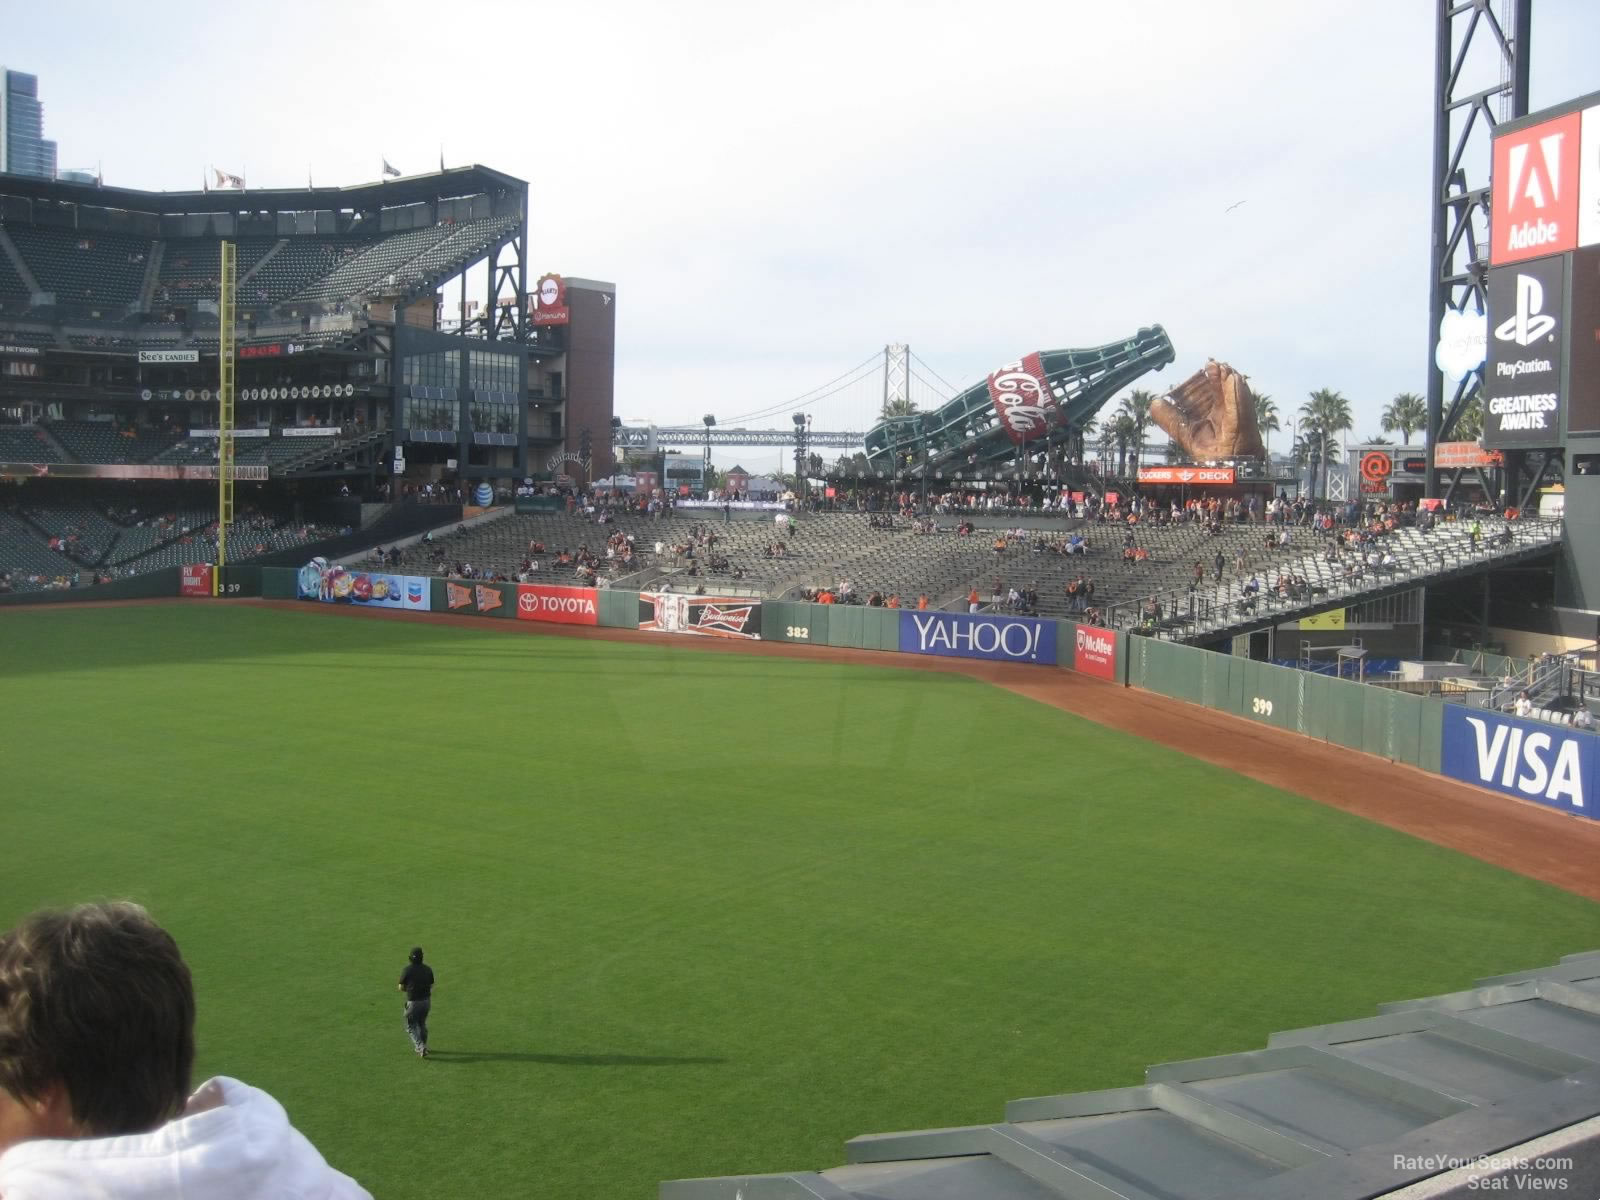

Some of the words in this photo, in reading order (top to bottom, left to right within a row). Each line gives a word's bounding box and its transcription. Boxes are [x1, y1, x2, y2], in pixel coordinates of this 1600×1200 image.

[1508, 217, 1557, 251] Adobe
[1489, 393, 1557, 414] GREATNESS
[1139, 471, 1172, 480] DOCKERS
[1199, 471, 1230, 480] DECK
[183, 566, 193, 576] FLY
[541, 596, 595, 614] TOYOTA
[698, 608, 749, 624] Budweiser
[786, 626, 809, 638] 382
[913, 614, 1041, 659] YAHOO!
[1085, 634, 1112, 656] McAfee
[1252, 697, 1273, 716] 399
[1465, 716, 1584, 807] VISA
